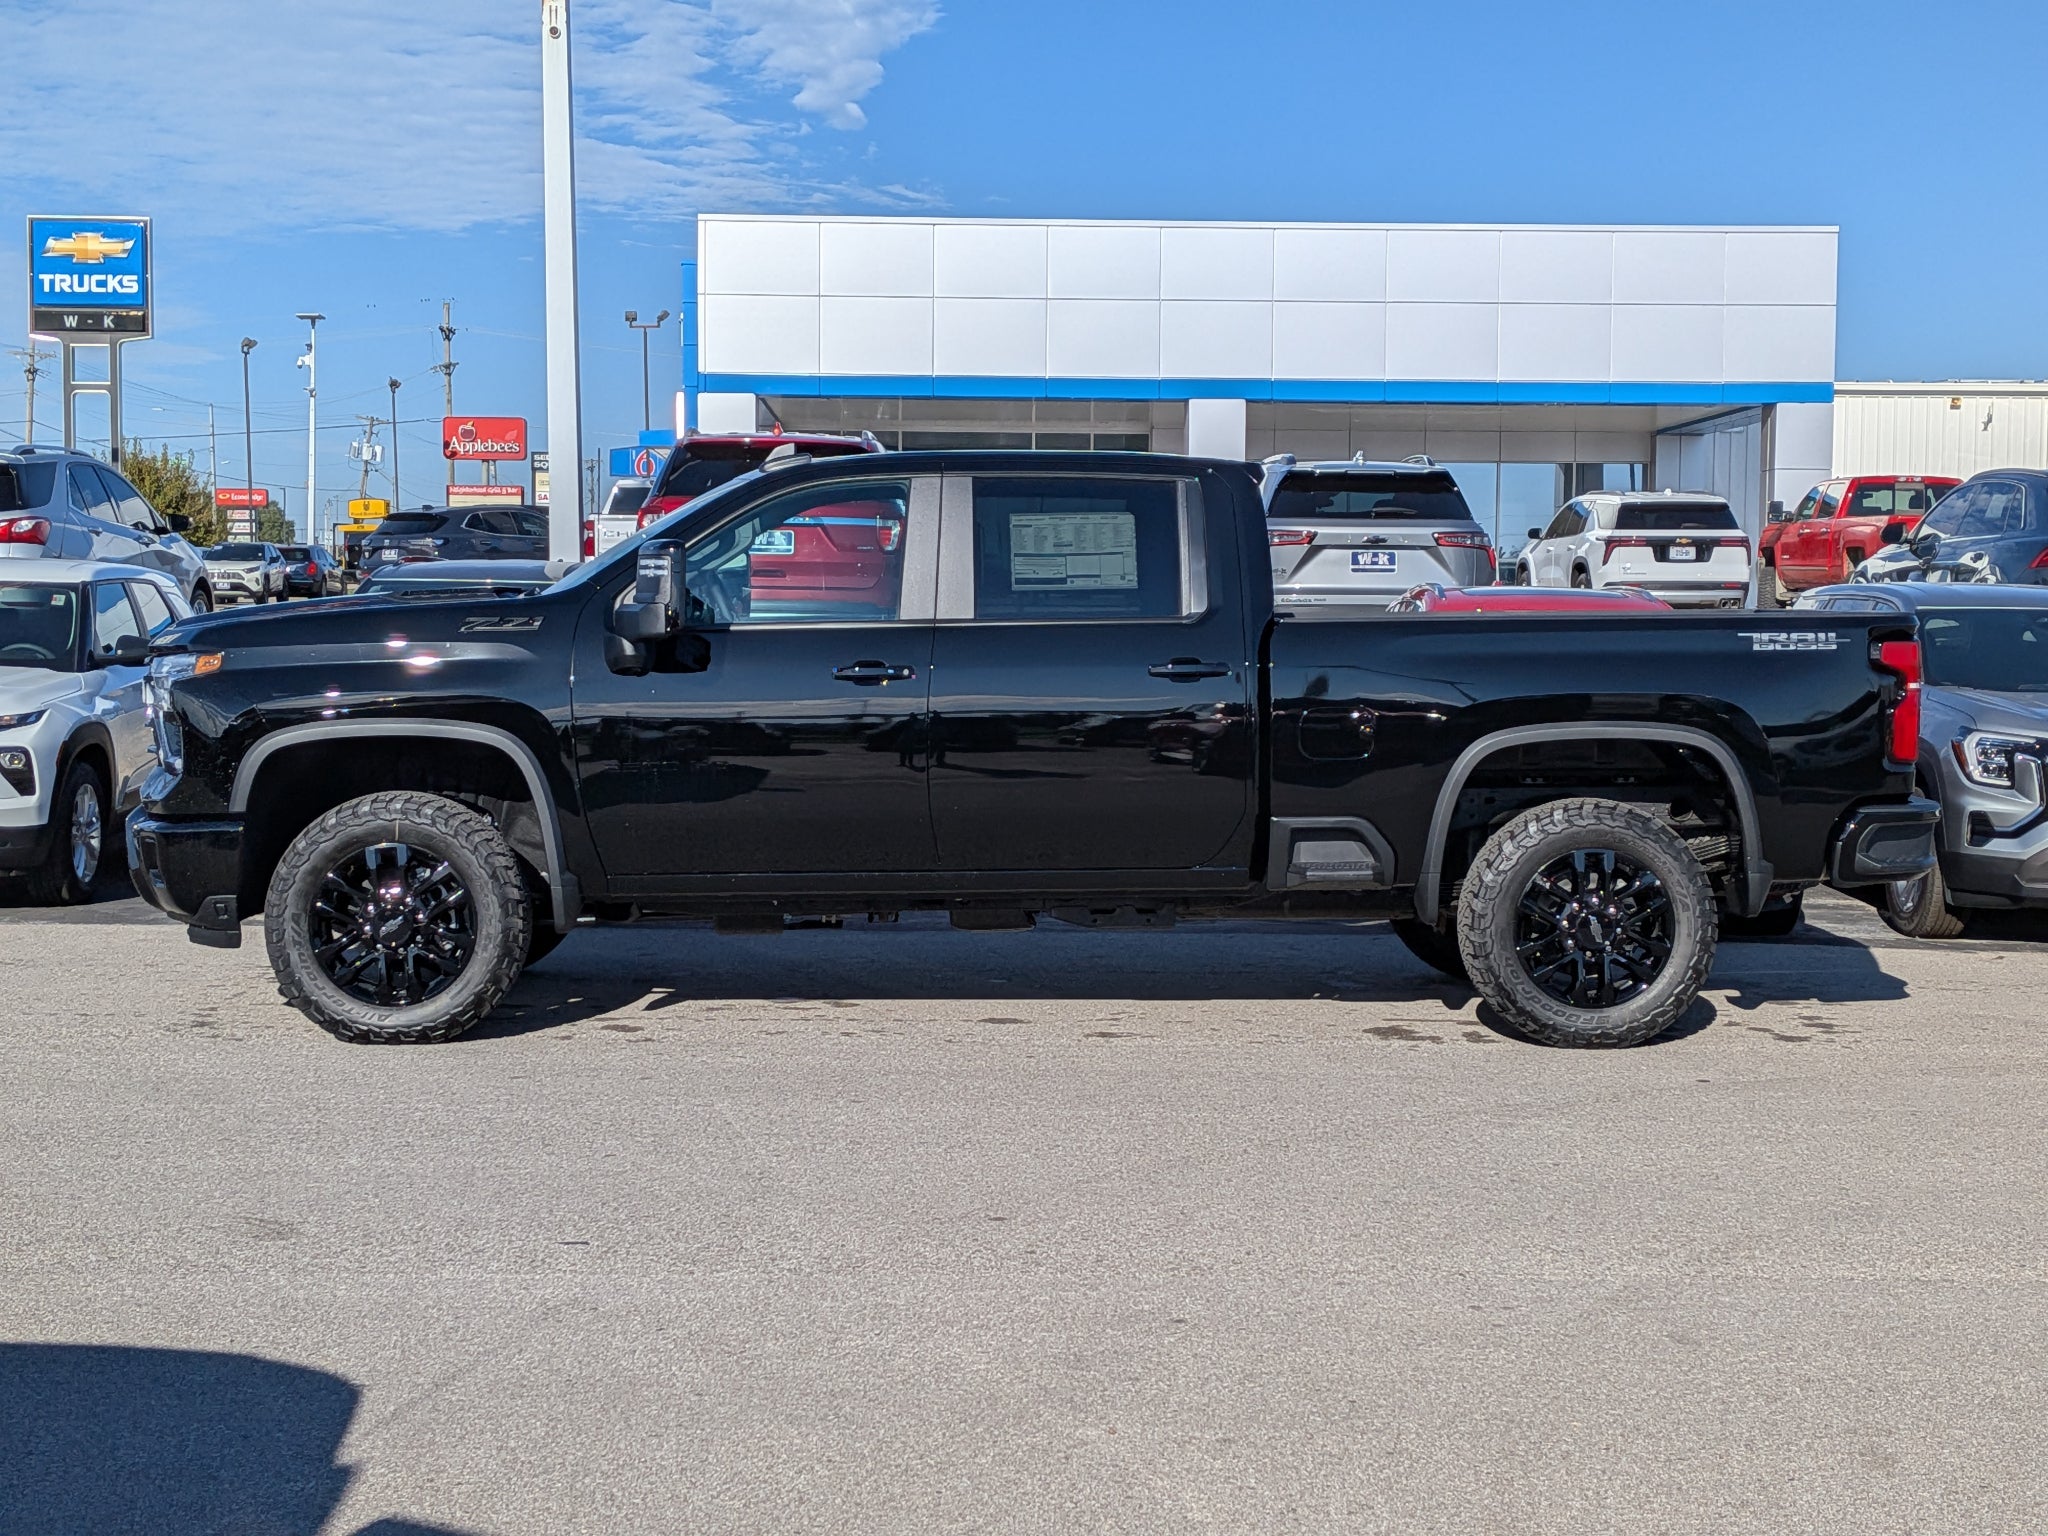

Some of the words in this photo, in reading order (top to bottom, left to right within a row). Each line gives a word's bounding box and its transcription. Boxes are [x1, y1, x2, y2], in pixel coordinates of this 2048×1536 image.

[38, 273, 139, 293] TRUCKS
[449, 436, 520, 456] Applebee's
[1358, 552, 1391, 565] W-K
[457, 616, 545, 633] Z71
[1737, 632, 1851, 643] TRAIL
[1753, 642, 1837, 651] BOSS
